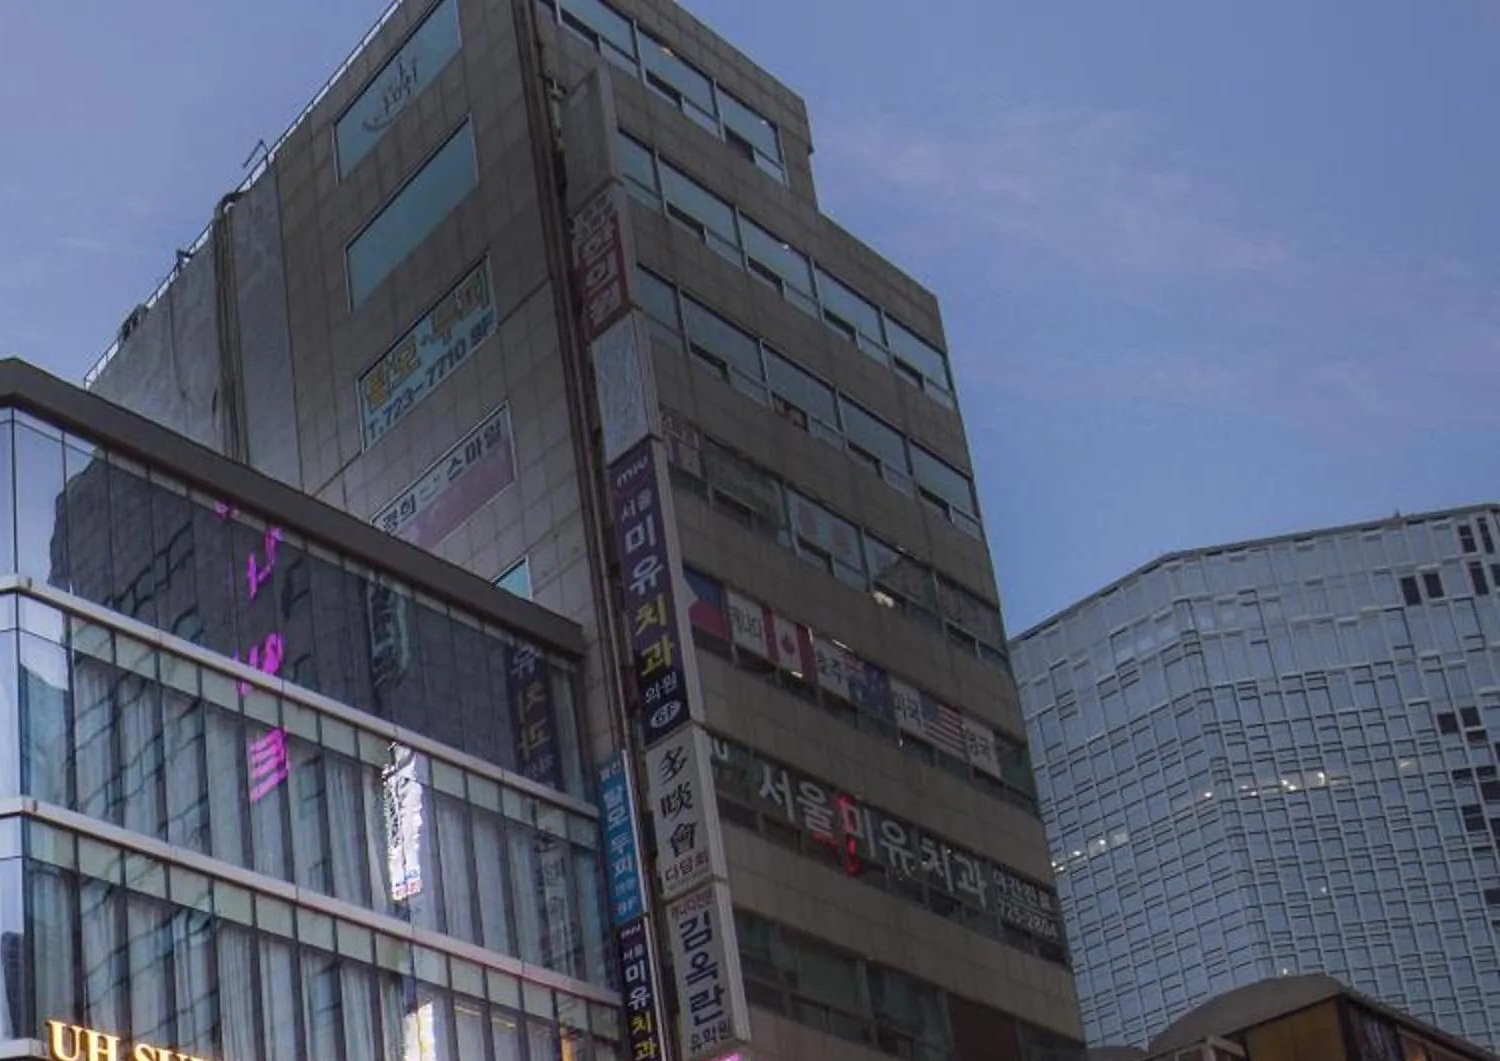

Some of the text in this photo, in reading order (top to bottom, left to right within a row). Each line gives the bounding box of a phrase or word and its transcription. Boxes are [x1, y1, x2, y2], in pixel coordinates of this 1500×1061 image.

[447, 420, 504, 482] 스마일
[625, 513, 676, 677] 미유치과
[679, 909, 726, 1028] 김옥란
[690, 1018, 733, 1054] 유학원
